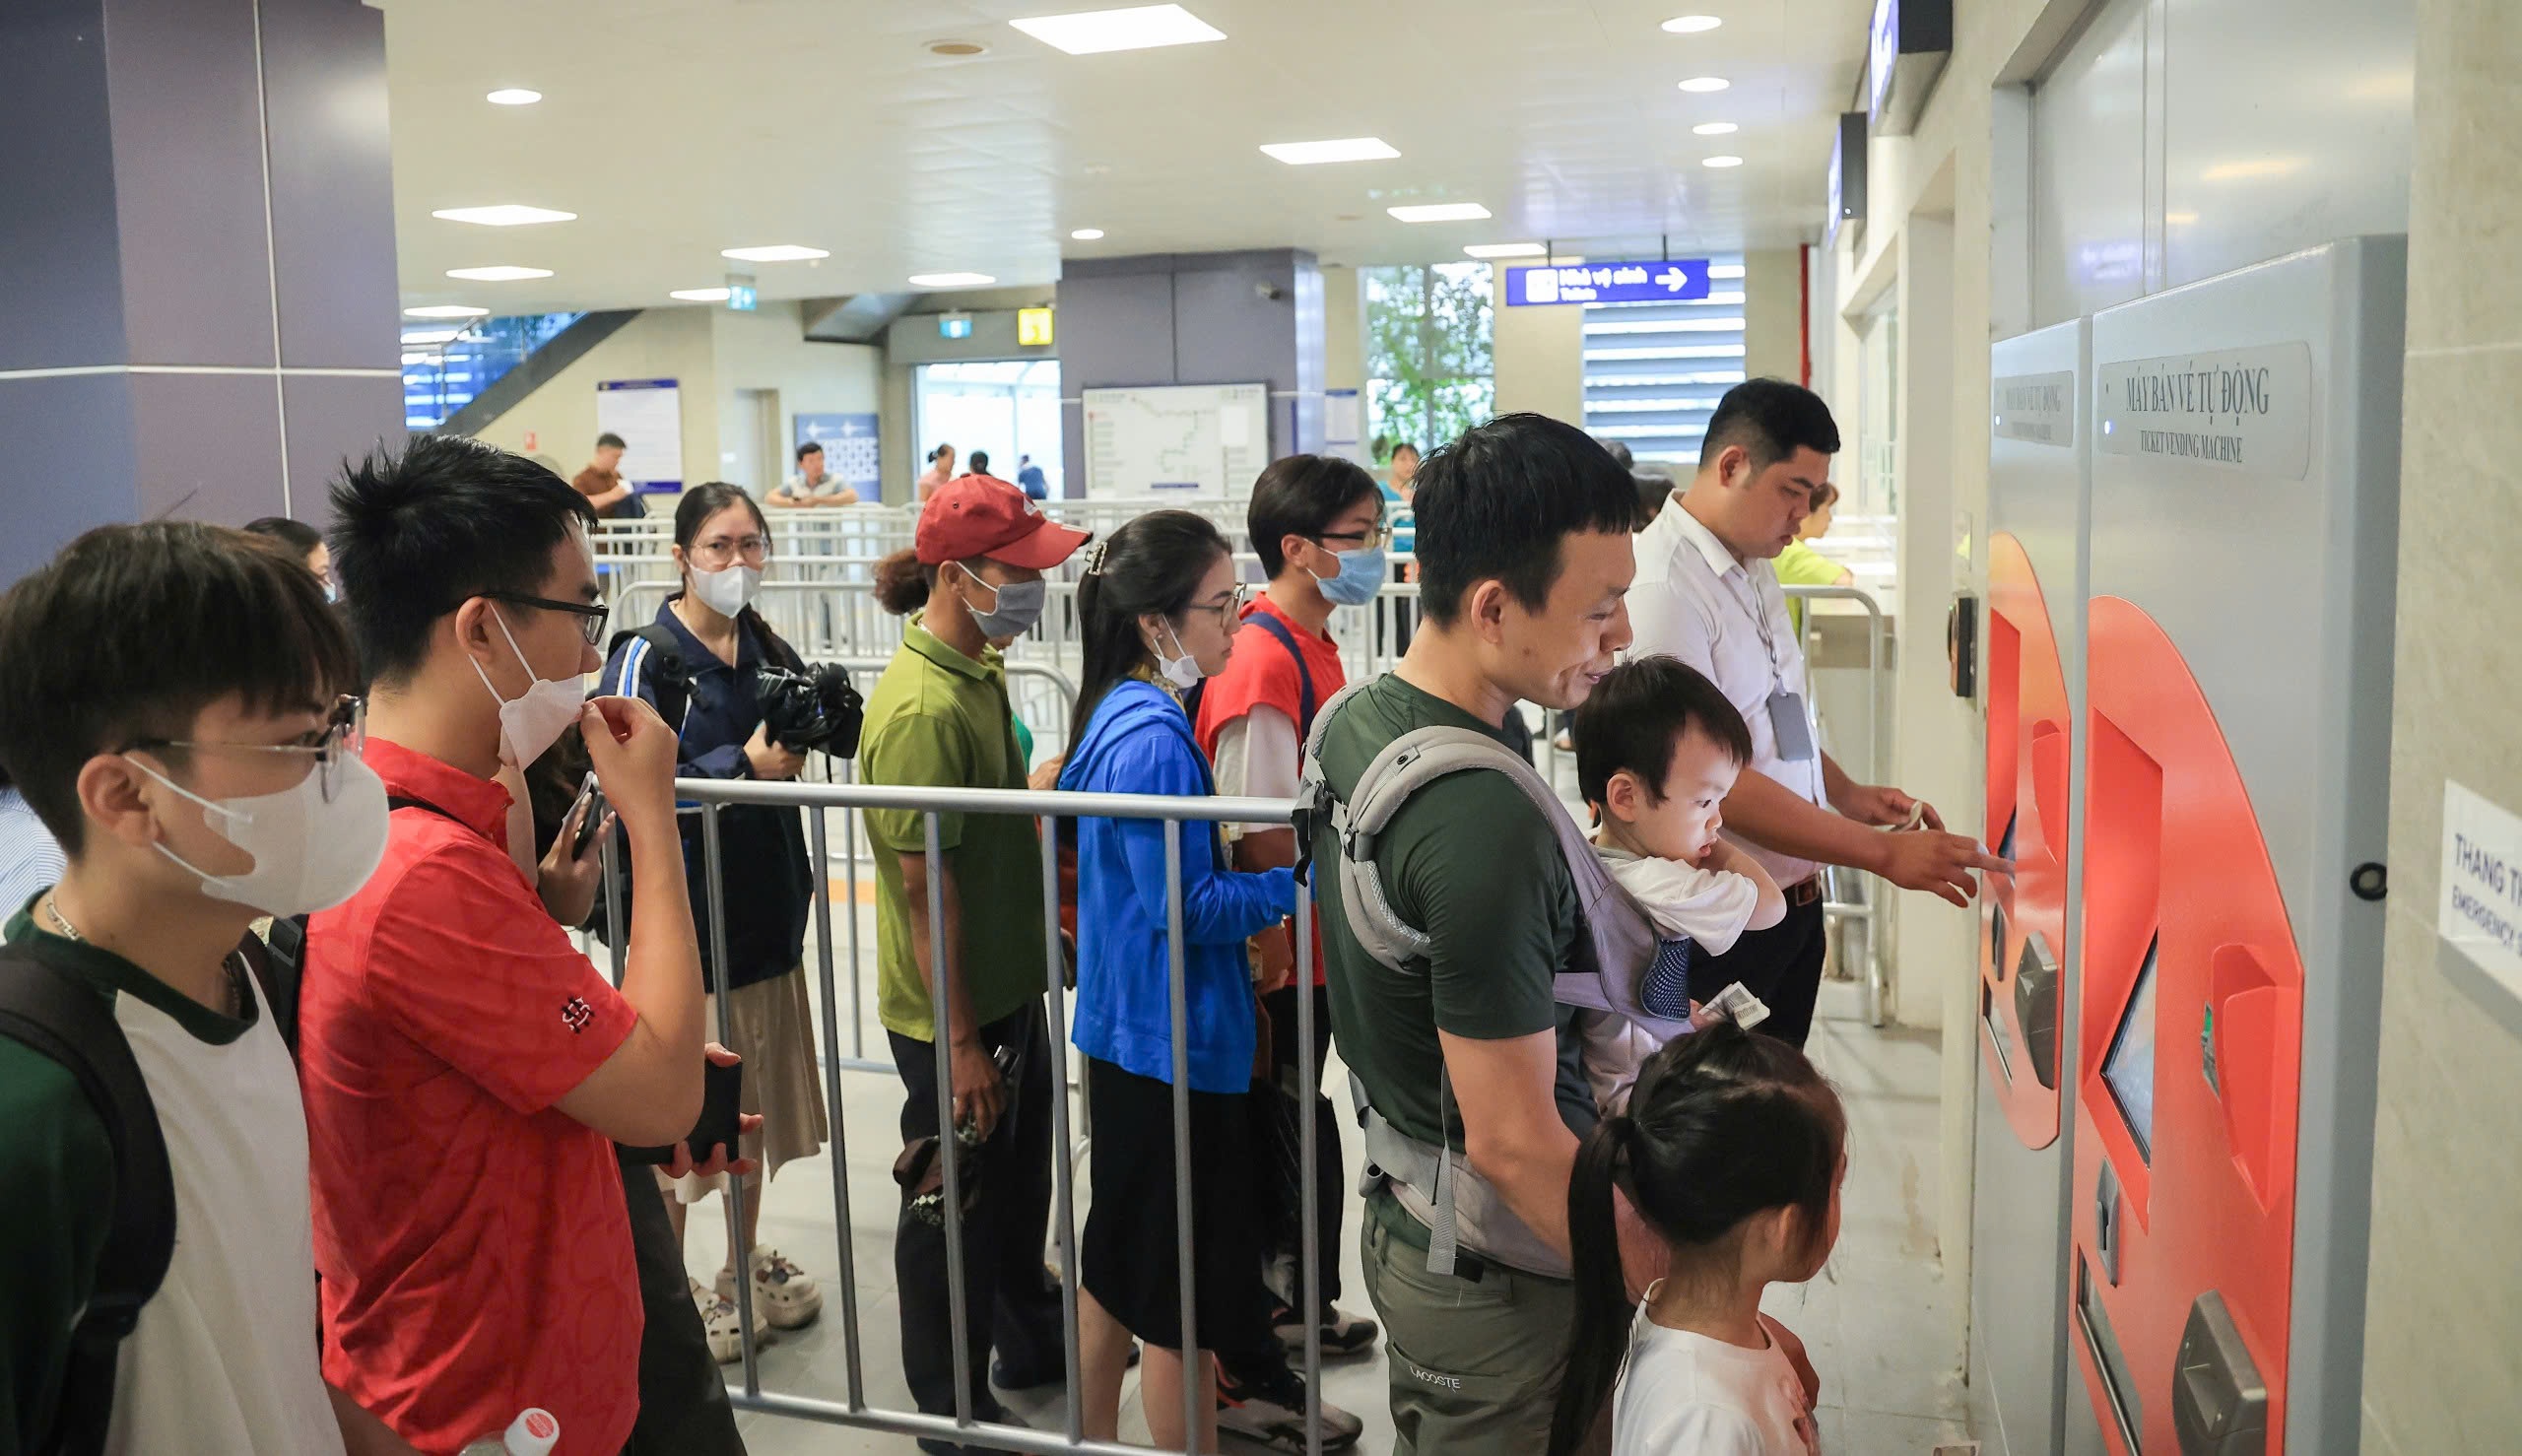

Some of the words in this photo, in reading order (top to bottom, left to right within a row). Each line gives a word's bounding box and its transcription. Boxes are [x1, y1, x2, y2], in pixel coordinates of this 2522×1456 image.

[2126, 364, 2150, 412] MÁY
[2152, 363, 2175, 412] BÁN
[2177, 360, 2195, 412] VÉ
[2198, 363, 2220, 426] TỰ
[2221, 362, 2270, 427] ĐỘNG
[2140, 430, 2164, 453] TICKET
[2165, 431, 2200, 458] VENDING
[2201, 435, 2243, 463] MACHINE
[2454, 831, 2505, 894] THANG
[2451, 884, 2515, 948] EMERGENCY
[1409, 1365, 1461, 1389] LACOSTE
